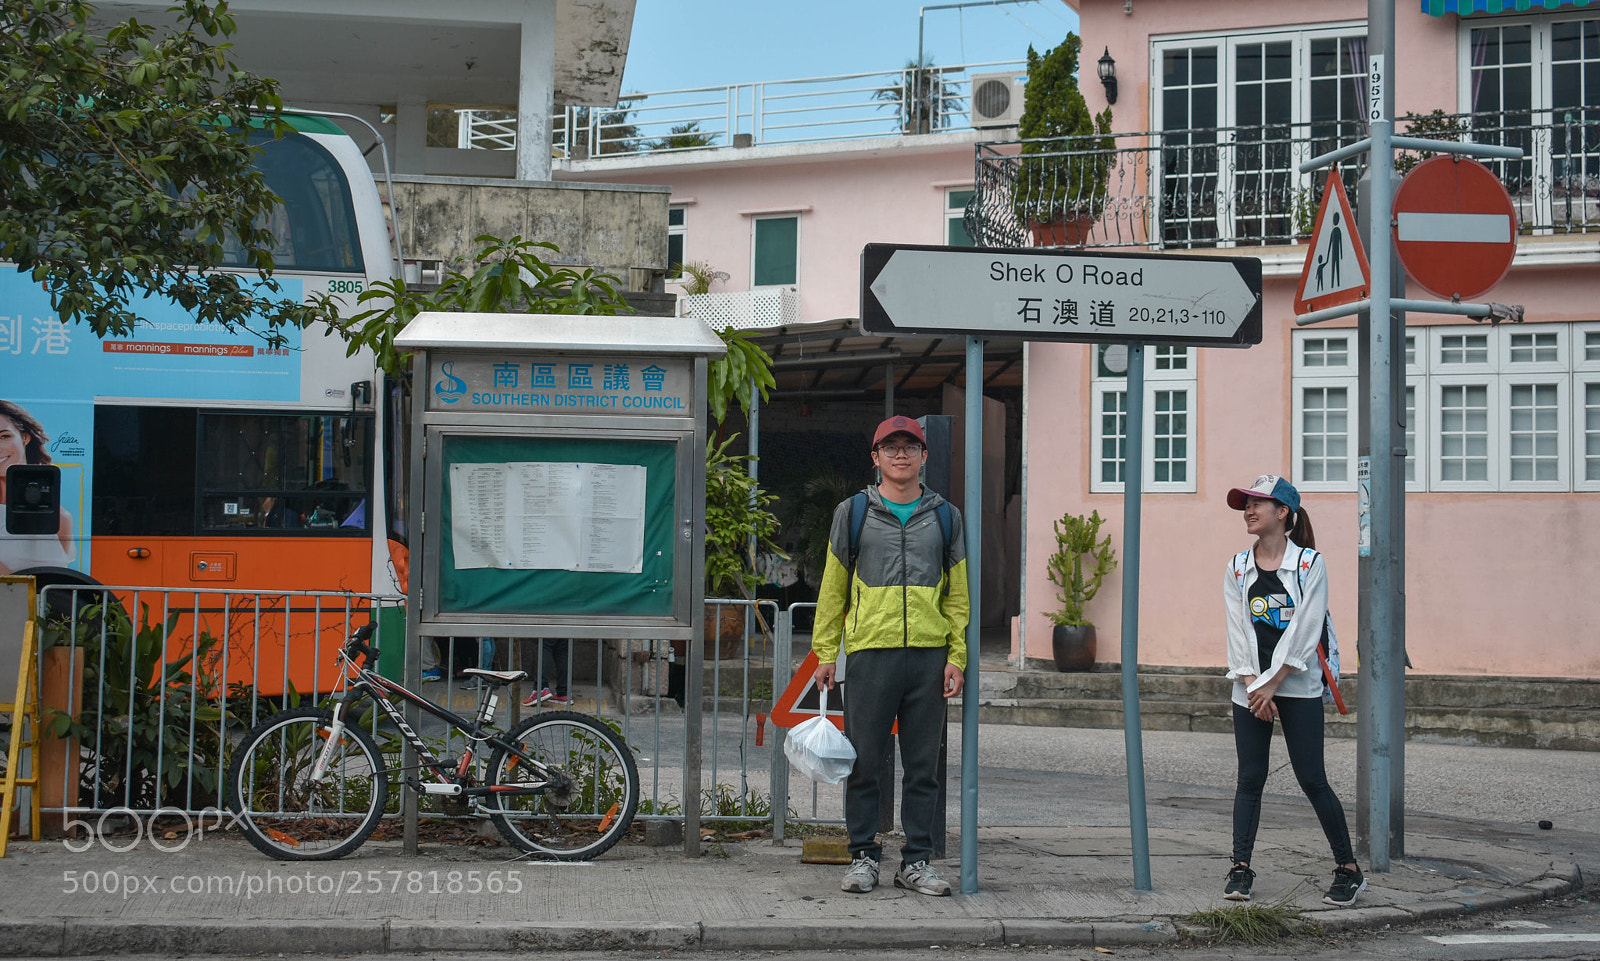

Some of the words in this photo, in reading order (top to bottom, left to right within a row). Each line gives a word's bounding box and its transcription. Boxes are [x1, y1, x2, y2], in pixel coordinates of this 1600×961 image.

[1371, 61, 1380, 119] 19570
[327, 279, 363, 294] 3805
[989, 261, 1046, 283] Shek
[1055, 263, 1074, 284] O
[1083, 265, 1144, 287] Road
[1016, 297, 1116, 327] 石澳道
[126, 343, 171, 354] mannings
[184, 345, 228, 356] mannings
[492, 360, 668, 392] 南區區議會
[472, 392, 550, 406] SOUTHERN
[554, 394, 617, 408] DISTRICT
[622, 395, 685, 409] COUNCIL
[377, 697, 438, 762] SCOTT
